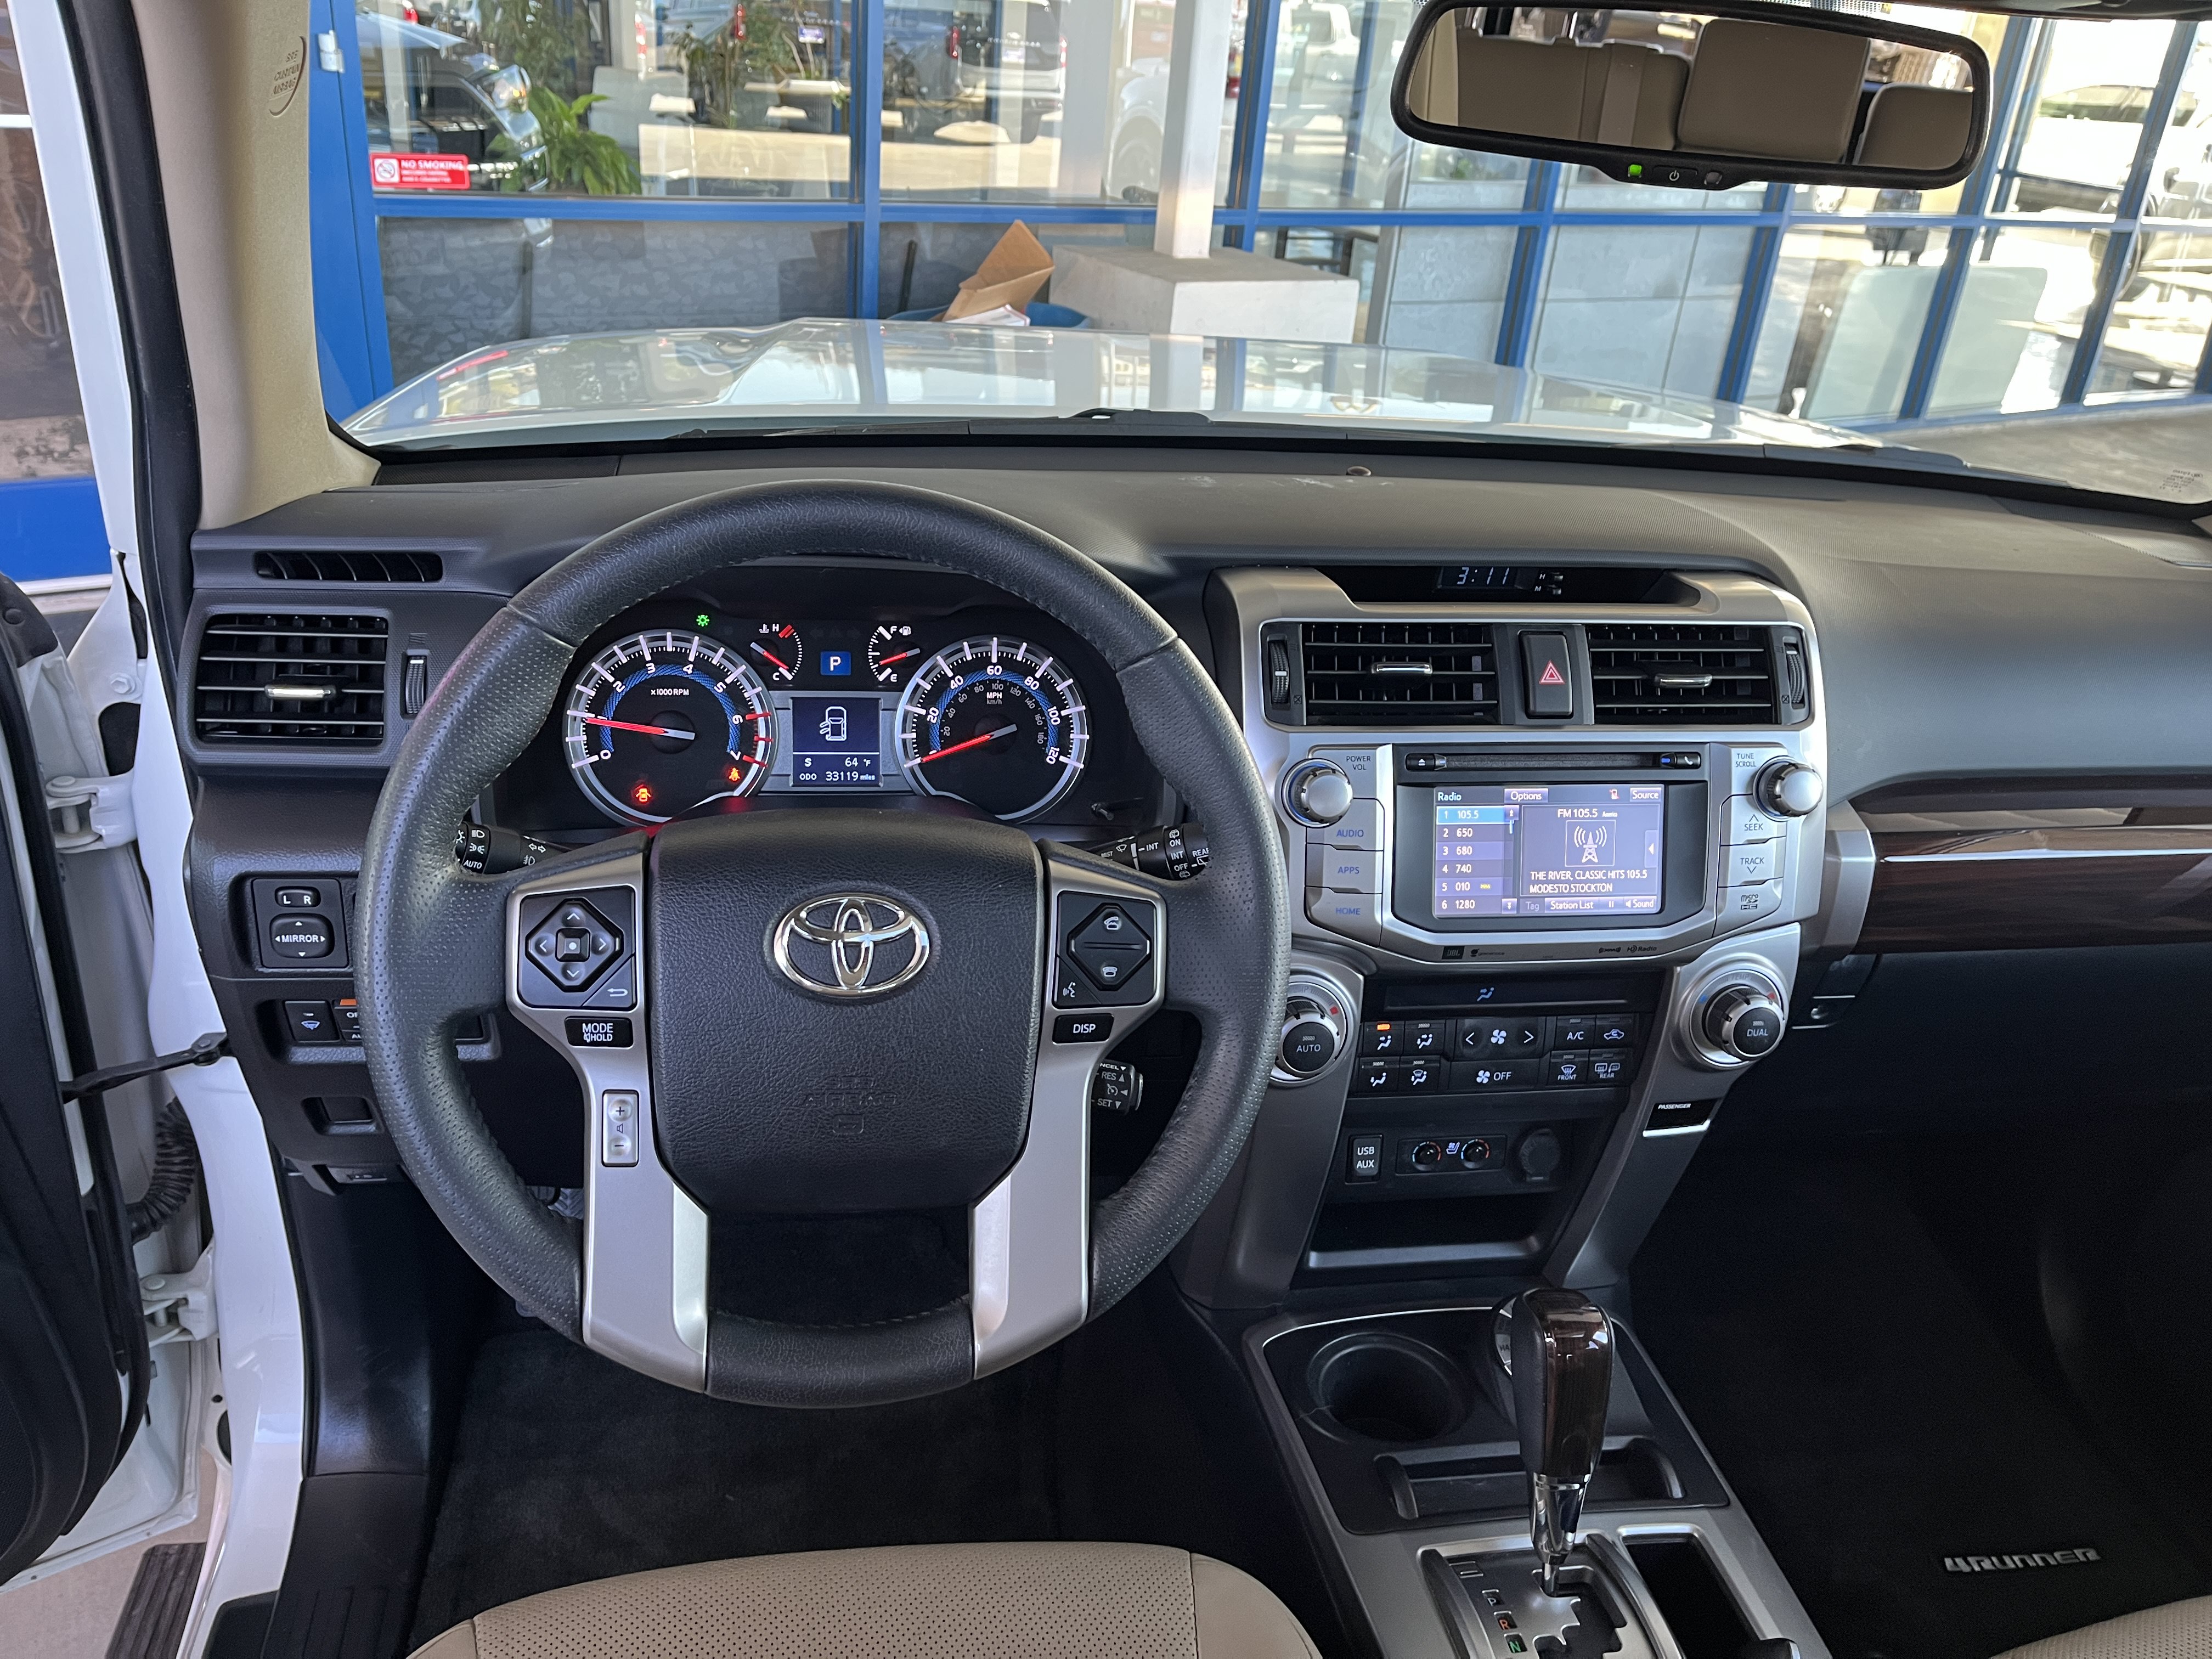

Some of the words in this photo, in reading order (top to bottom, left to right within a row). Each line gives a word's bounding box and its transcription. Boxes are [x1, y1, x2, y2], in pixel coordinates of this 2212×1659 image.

[401, 160, 415, 168] NO
[417, 160, 464, 170] SMOKING
[1457, 567, 1510, 585] 3:11
[647, 663, 656, 674] 3
[830, 656, 841, 671] P
[683, 664, 693, 674] 4
[987, 665, 1002, 675] 60
[772, 673, 780, 681] C
[890, 674, 898, 682] E
[613, 680, 625, 692] 2
[714, 681, 726, 692] 5
[950, 675, 964, 690] 40
[1024, 676, 1040, 690] 80
[974, 684, 984, 693] 80
[1009, 686, 1022, 697] 120
[958, 693, 968, 703] 60
[1025, 698, 1035, 710] 140
[927, 707, 939, 724] 20
[947, 707, 956, 719] 40
[1047, 706, 1060, 725] 100
[732, 714, 743, 724] 6
[1035, 714, 1043, 726] 160
[943, 726, 951, 736] 20
[600, 751, 612, 760] 0
[730, 751, 741, 760] 7
[1046, 747, 1060, 765] 120
[804, 758, 812, 767] S
[845, 757, 858, 766] 64
[799, 773, 817, 781] ODO
[825, 771, 859, 782] 33119
[1437, 792, 1462, 802] Radio
[1510, 791, 1543, 802] Options
[1632, 791, 1659, 799] Source
[1443, 810, 1449, 819] 1
[1457, 810, 1480, 819] 105.5
[1558, 808, 1572, 818] FM
[1573, 808, 1599, 818] 105.5
[1744, 823, 1764, 831] SEEK
[1336, 829, 1364, 838] AUDIO
[1443, 828, 1449, 837] 2
[1457, 828, 1473, 837] 650
[1146, 842, 1159, 851] INT
[1169, 839, 1181, 847] ON
[1171, 851, 1184, 860] INT
[1442, 846, 1449, 855] 3
[1456, 846, 1472, 855] 680
[464, 860, 482, 869] AUTO
[1740, 857, 1764, 866] TRACK
[1173, 863, 1188, 872] OFF
[1338, 866, 1359, 874] APPS
[1442, 864, 1448, 873] 4
[1455, 864, 1472, 873] 740
[1530, 871, 1546, 881] THE
[1548, 871, 1573, 881] RIVER,
[1575, 870, 1606, 880] CLASSIC
[1607, 870, 1626, 879] HITS
[1627, 870, 1648, 879] 105.5
[1442, 882, 1448, 891] 5
[1455, 882, 1470, 891] 010
[1530, 883, 1570, 894] MODESTO
[1570, 883, 1613, 893] STOCKTON
[283, 895, 291, 905] L
[303, 895, 312, 905] R
[1442, 900, 1448, 909] 6
[1455, 900, 1475, 909] 1280
[1550, 900, 1577, 910] Station
[1578, 900, 1594, 910] List
[1633, 899, 1655, 909] Sound
[1336, 907, 1361, 916] HOME
[1526, 901, 1540, 912] Tag
[281, 934, 319, 943] MIRROR
[582, 1022, 613, 1034] MODE
[1073, 1024, 1096, 1034] DISP
[1746, 1028, 1769, 1037] DUAL
[590, 1032, 613, 1042] HOLD
[1567, 1031, 1584, 1041] A/C
[1296, 1043, 1321, 1052] AUTO
[1101, 1071, 1117, 1081] RES
[1493, 1071, 1512, 1081] OFF
[1097, 1098, 1113, 1107] SET
[1357, 1146, 1375, 1156] USB
[1356, 1160, 1374, 1169] AUX
[1487, 1597, 1497, 1606] P
[1499, 1619, 1510, 1630] R
[1509, 1641, 1521, 1653] N
